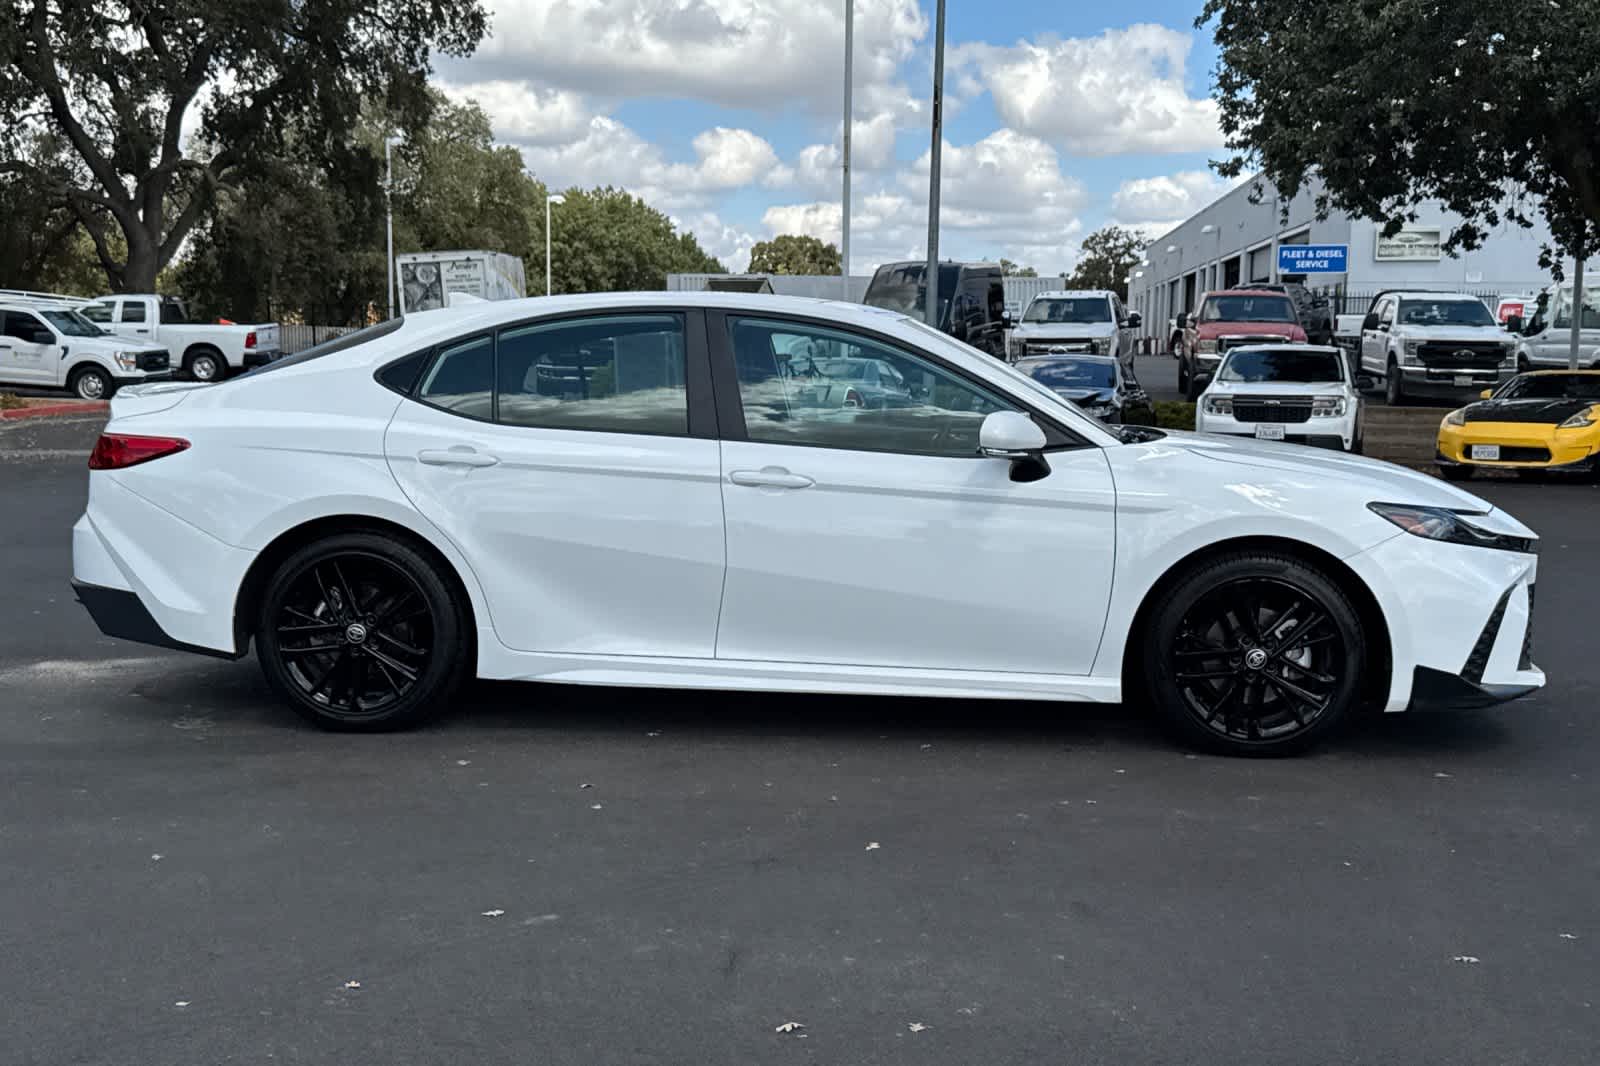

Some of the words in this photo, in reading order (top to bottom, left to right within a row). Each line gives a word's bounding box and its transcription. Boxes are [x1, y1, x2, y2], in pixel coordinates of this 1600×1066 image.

[1282, 250, 1306, 258] FLEET
[1307, 250, 1314, 258] &
[1316, 249, 1345, 258] DIESEL
[1296, 260, 1329, 268] SERVICE
